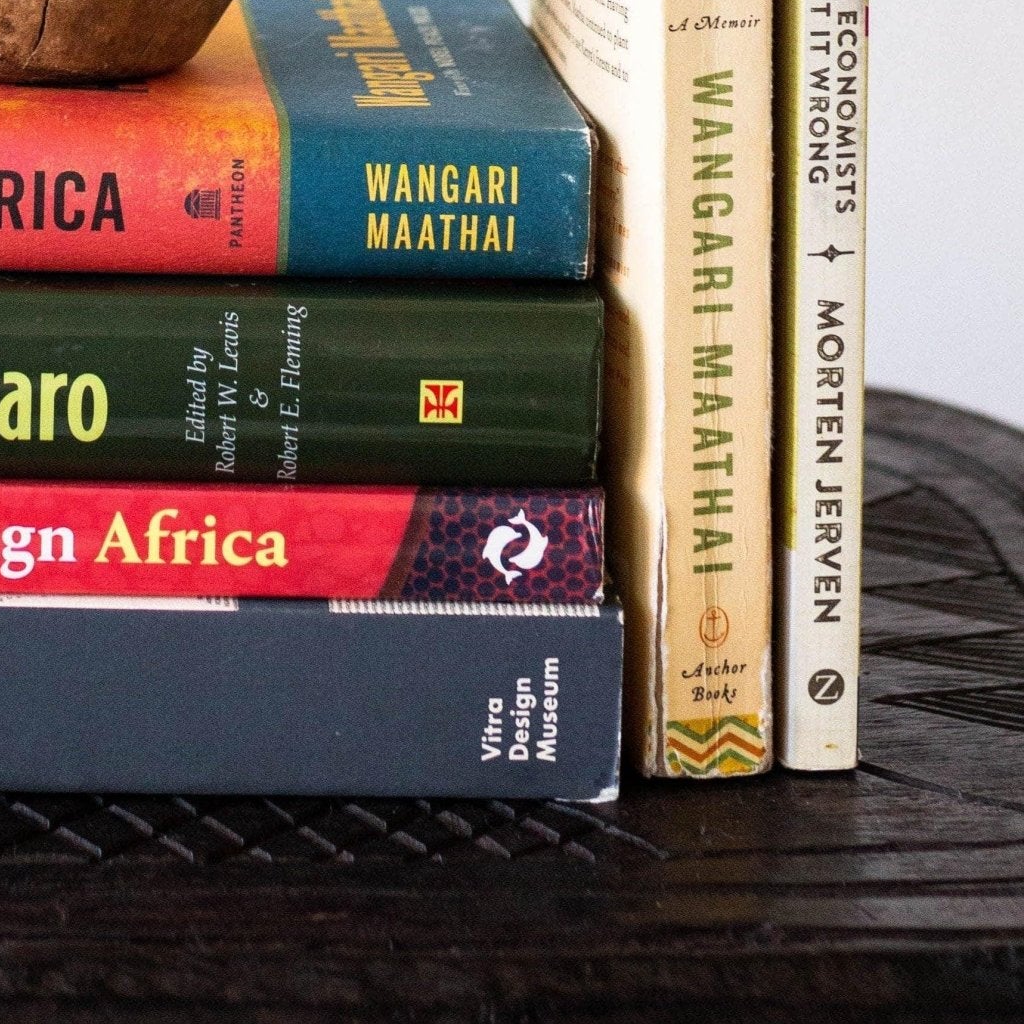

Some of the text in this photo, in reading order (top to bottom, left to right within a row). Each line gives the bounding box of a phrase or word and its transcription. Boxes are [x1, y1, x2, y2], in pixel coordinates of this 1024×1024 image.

[669, 15, 761, 32] A Memoir
[811, 31, 830, 54] IT
[809, 67, 829, 183] WRONG
[836, 11, 857, 213] ECONOMISTS
[228, 159, 244, 250] PANTHEON
[365, 163, 519, 204] WANGARI
[366, 213, 515, 252] MAATHAI
[692, 70, 733, 574] WANGARI MAATHAI
[185, 347, 214, 444] Edited by
[215, 311, 239, 474] Robert W. Lewis
[249, 388, 269, 408] &
[277, 303, 309, 480] Robert E. Fleming
[814, 299, 844, 623] MORTEN JERVEN
[94, 508, 289, 567] Africa
[535, 657, 560, 762] Museum
[682, 659, 747, 679] Anchor
[691, 683, 737, 704] Books
[480, 697, 504, 762] Vitra
[508, 677, 537, 761] Design
